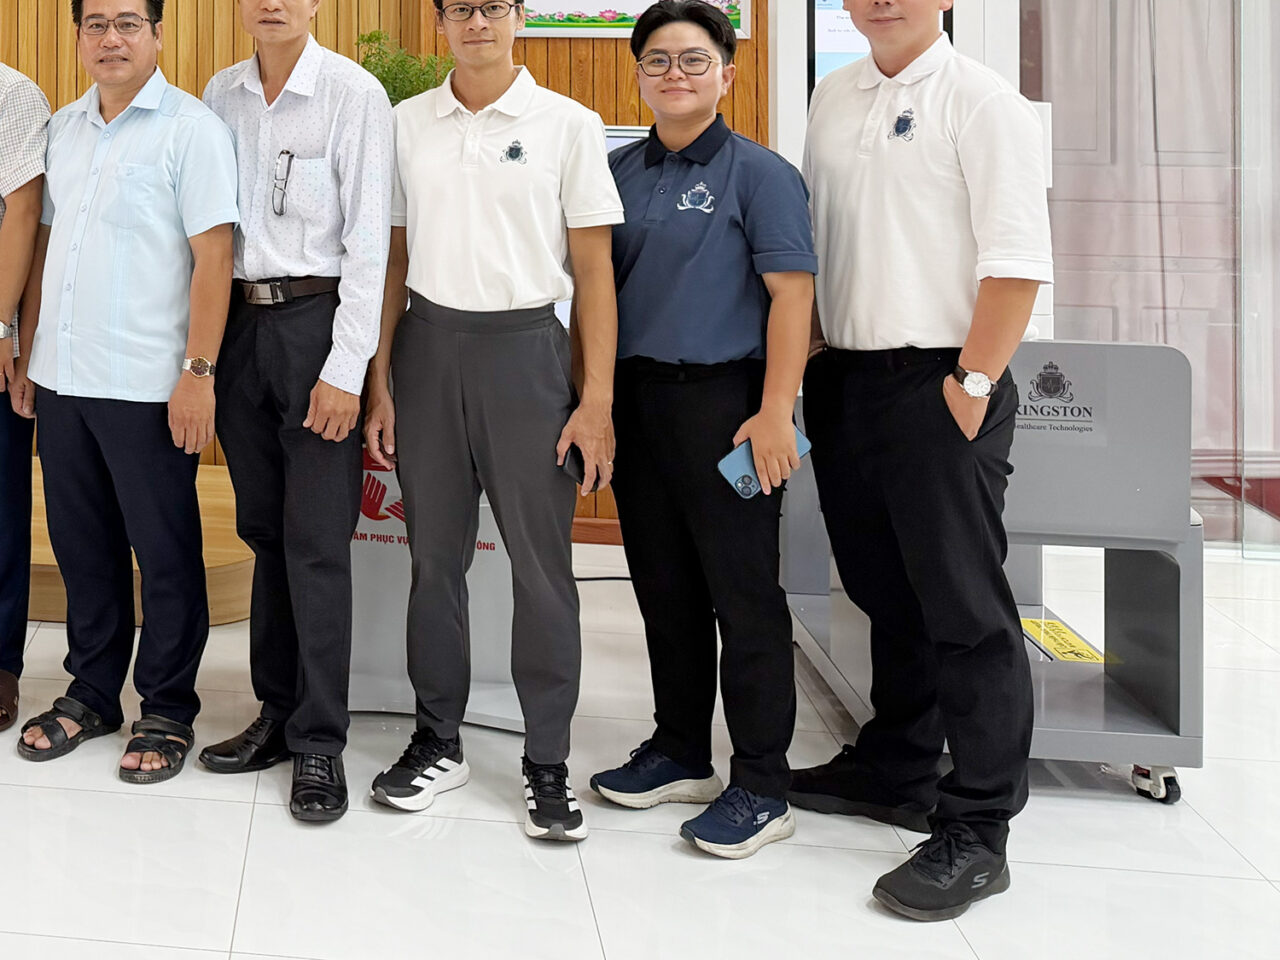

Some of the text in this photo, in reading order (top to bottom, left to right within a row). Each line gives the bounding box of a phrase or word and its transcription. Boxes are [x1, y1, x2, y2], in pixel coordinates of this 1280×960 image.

[1048, 424, 1093, 432] Technologies
[353, 530, 368, 541] ÂM
[370, 534, 394, 545] PHỤC
[476, 540, 496, 551] ÔNG
